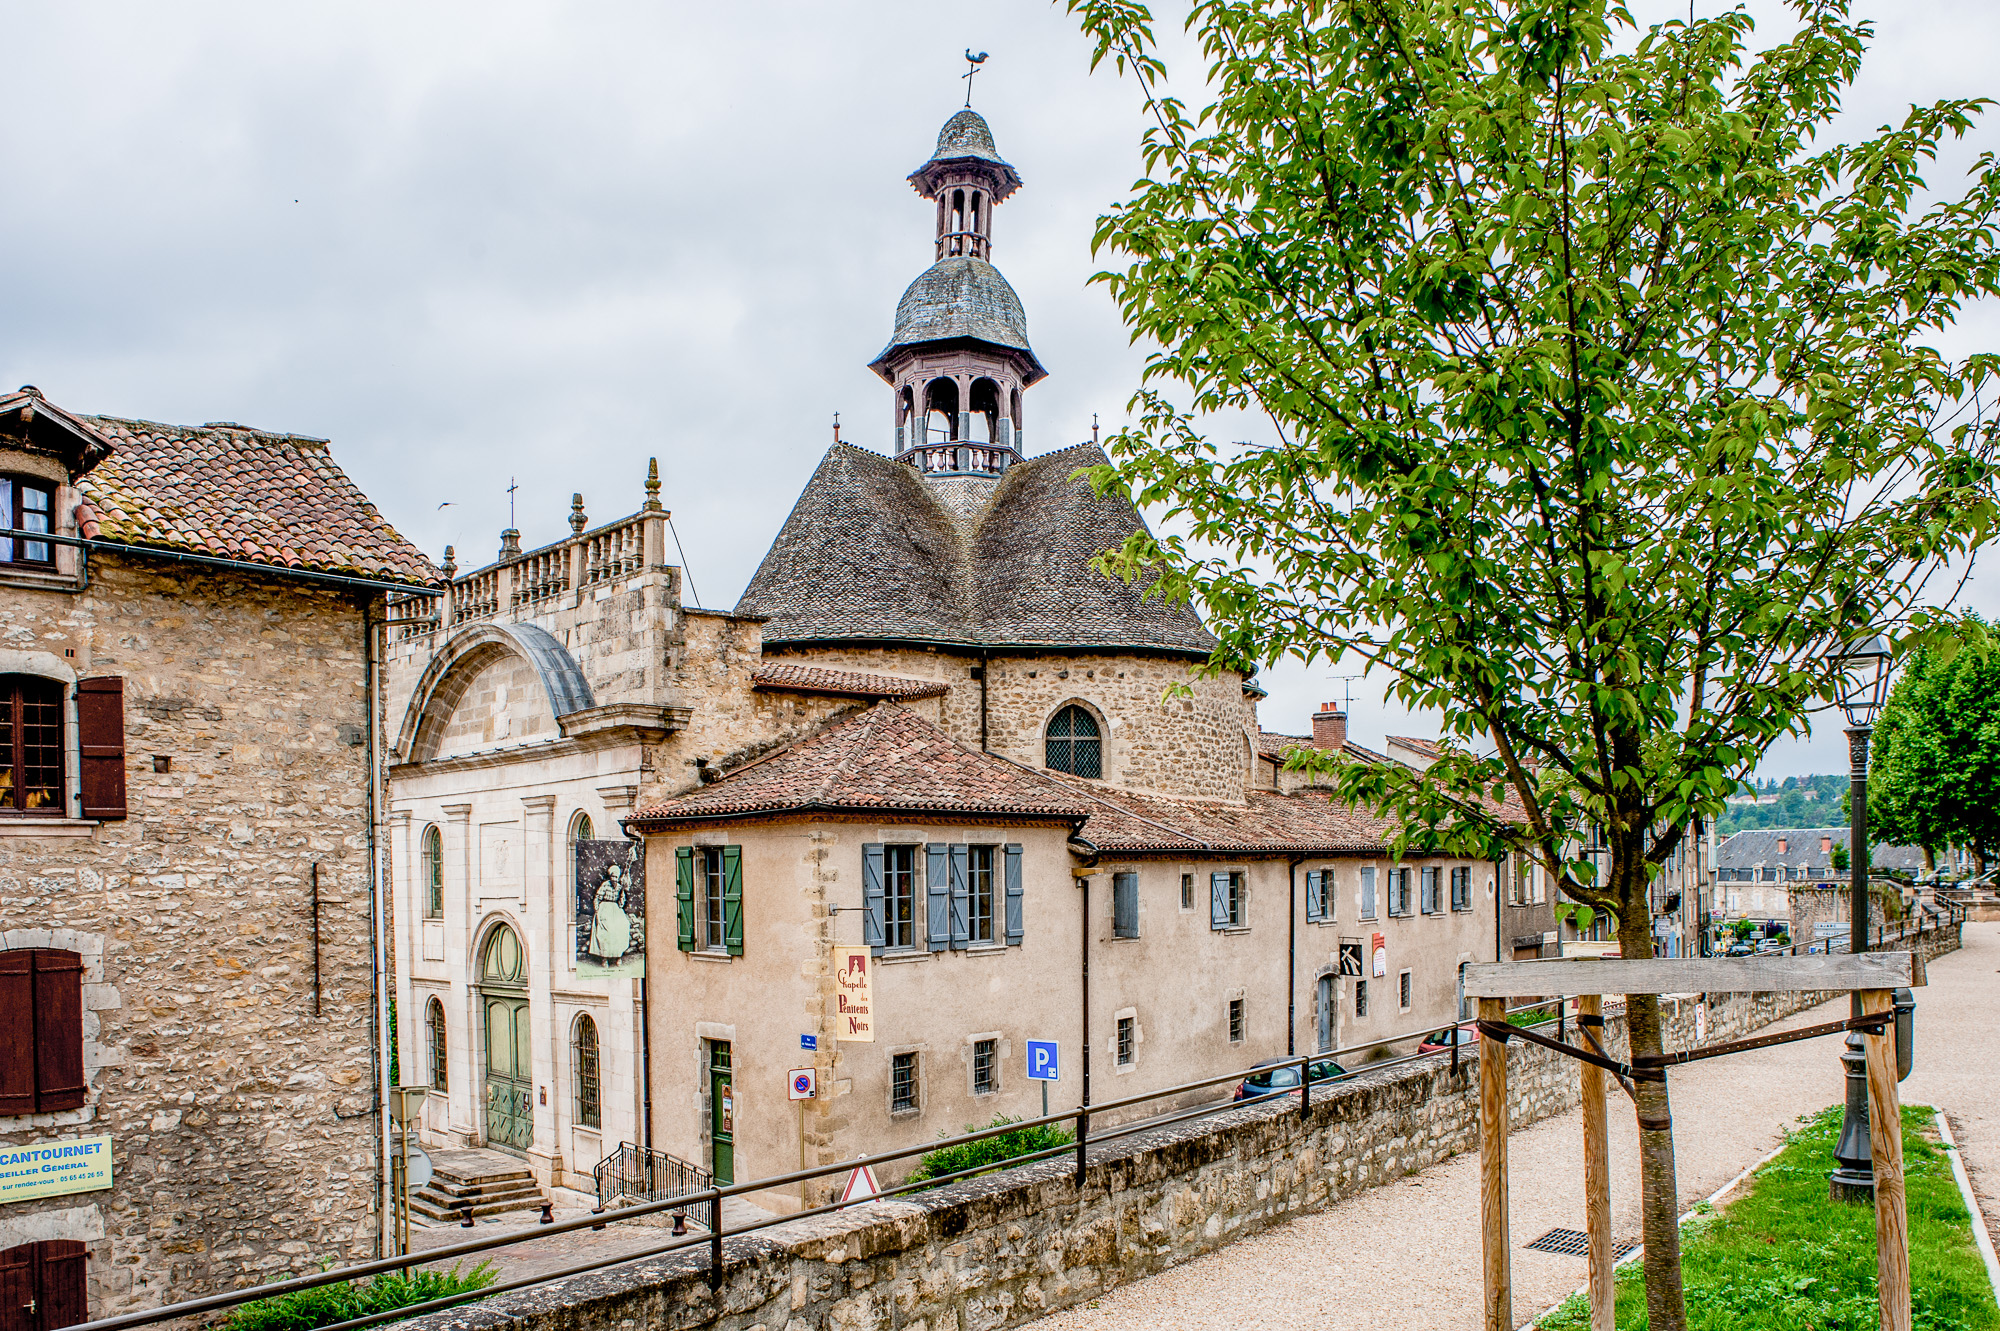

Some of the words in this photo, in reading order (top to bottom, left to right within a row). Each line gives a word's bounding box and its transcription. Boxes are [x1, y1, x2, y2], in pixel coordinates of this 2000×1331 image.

[838, 968, 867, 992] Chapelle
[848, 1016, 869, 1034] Noirs
[1035, 1047, 1050, 1072] P
[0, 1143, 102, 1165] CANTOURNET
[15, 1179, 55, 1189] rendez-vous
